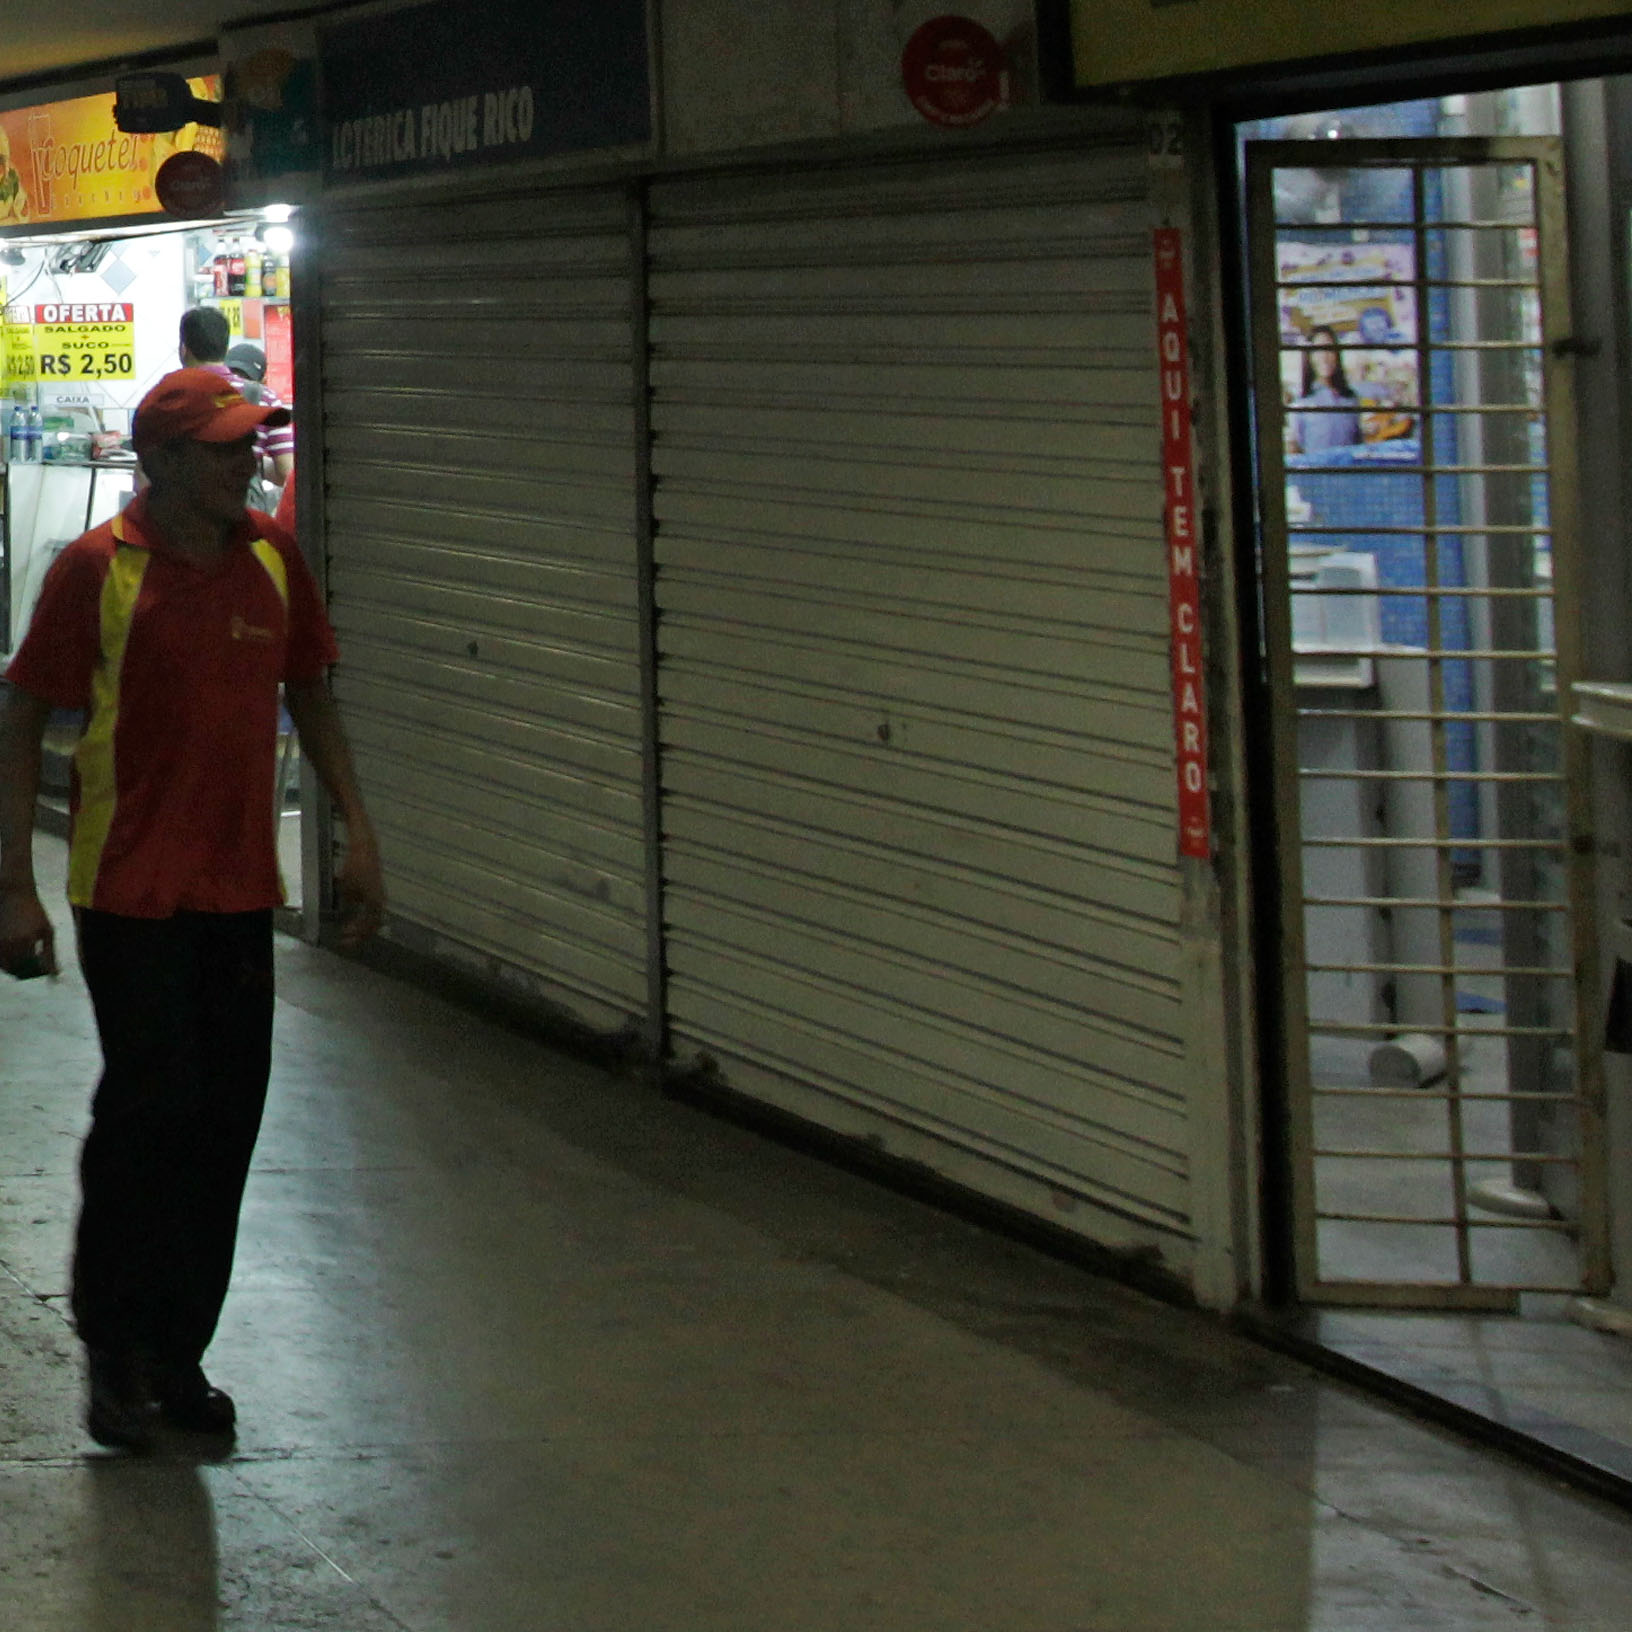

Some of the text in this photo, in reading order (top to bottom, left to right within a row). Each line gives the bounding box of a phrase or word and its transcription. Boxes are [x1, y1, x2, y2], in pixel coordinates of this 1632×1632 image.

[420, 94, 478, 162] FIQUE
[481, 85, 535, 147] RICO
[40, 129, 139, 191] Coquetel
[43, 303, 126, 322] OFERTA
[44, 324, 126, 333] SALGADO
[62, 341, 109, 349] SUCO
[41, 353, 132, 378] R$ 2,50
[56, 395, 90, 404] CAIXA
[1161, 292, 1204, 793] AQUI TEM CLARO
